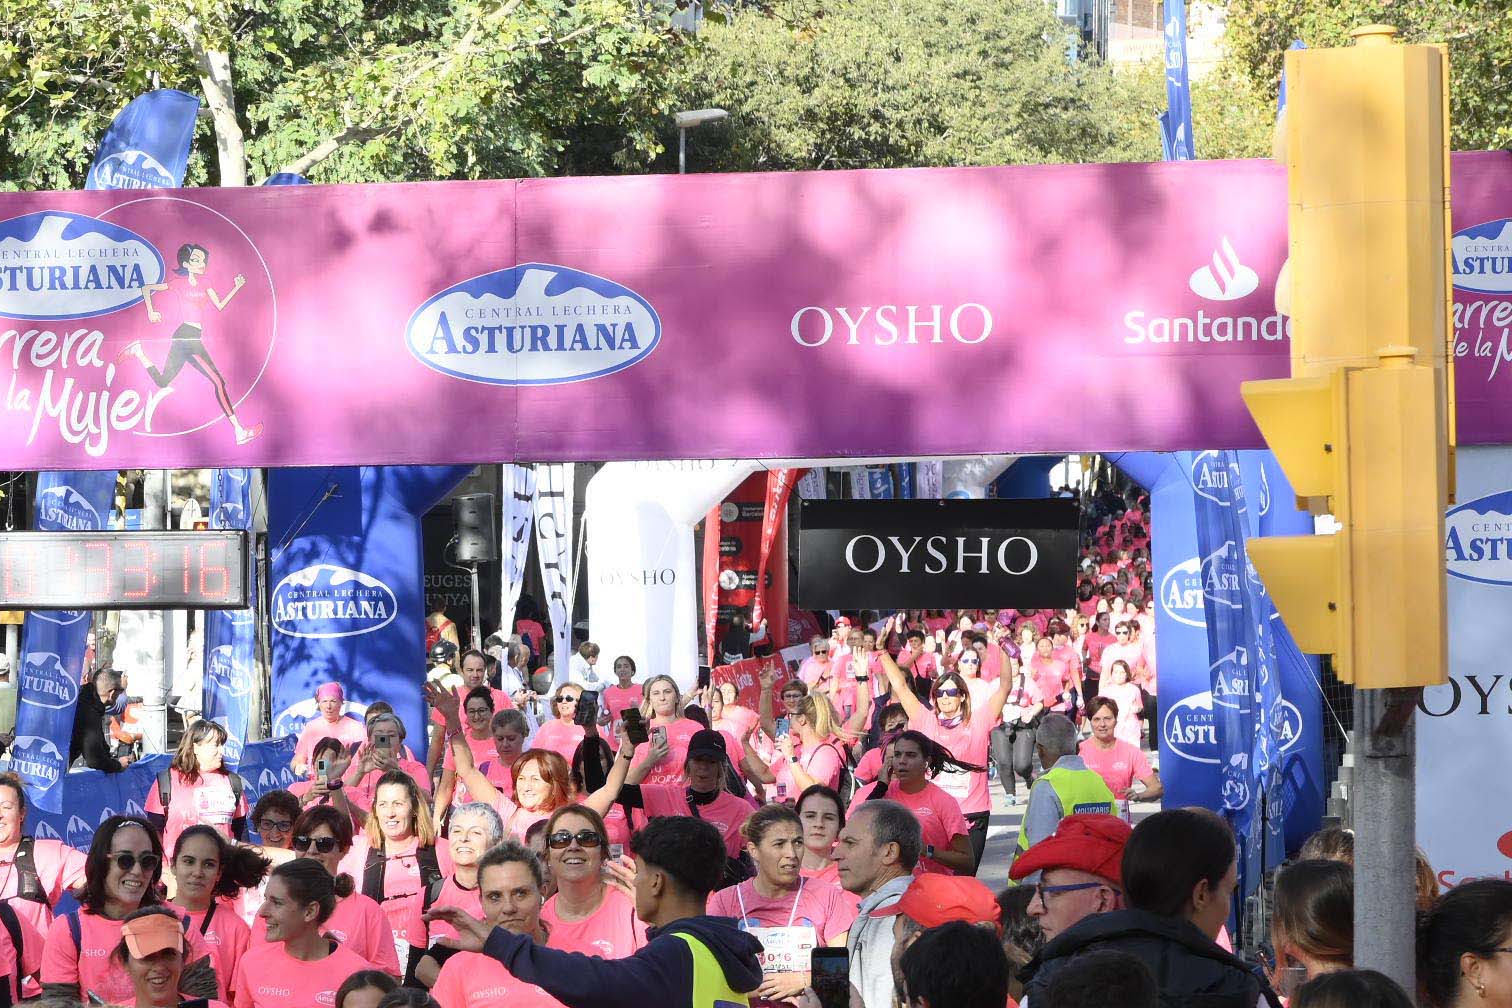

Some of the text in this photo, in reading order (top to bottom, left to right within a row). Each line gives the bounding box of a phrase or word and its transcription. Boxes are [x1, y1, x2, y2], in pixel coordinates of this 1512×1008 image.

[68, 247, 140, 258] LECHERA
[465, 303, 633, 318] CENTRAL LECHERA
[790, 302, 993, 347] OYSHO
[426, 310, 642, 355] ASTURIANA
[1474, 331, 1493, 358] la
[7, 373, 31, 411] la
[26, 364, 174, 457] Mujer
[845, 534, 1039, 576] OYSHO
[275, 594, 389, 622] ASTURIANA
[287, 589, 384, 599] CENTRAL LECHERA
[1416, 674, 1512, 718] OY
